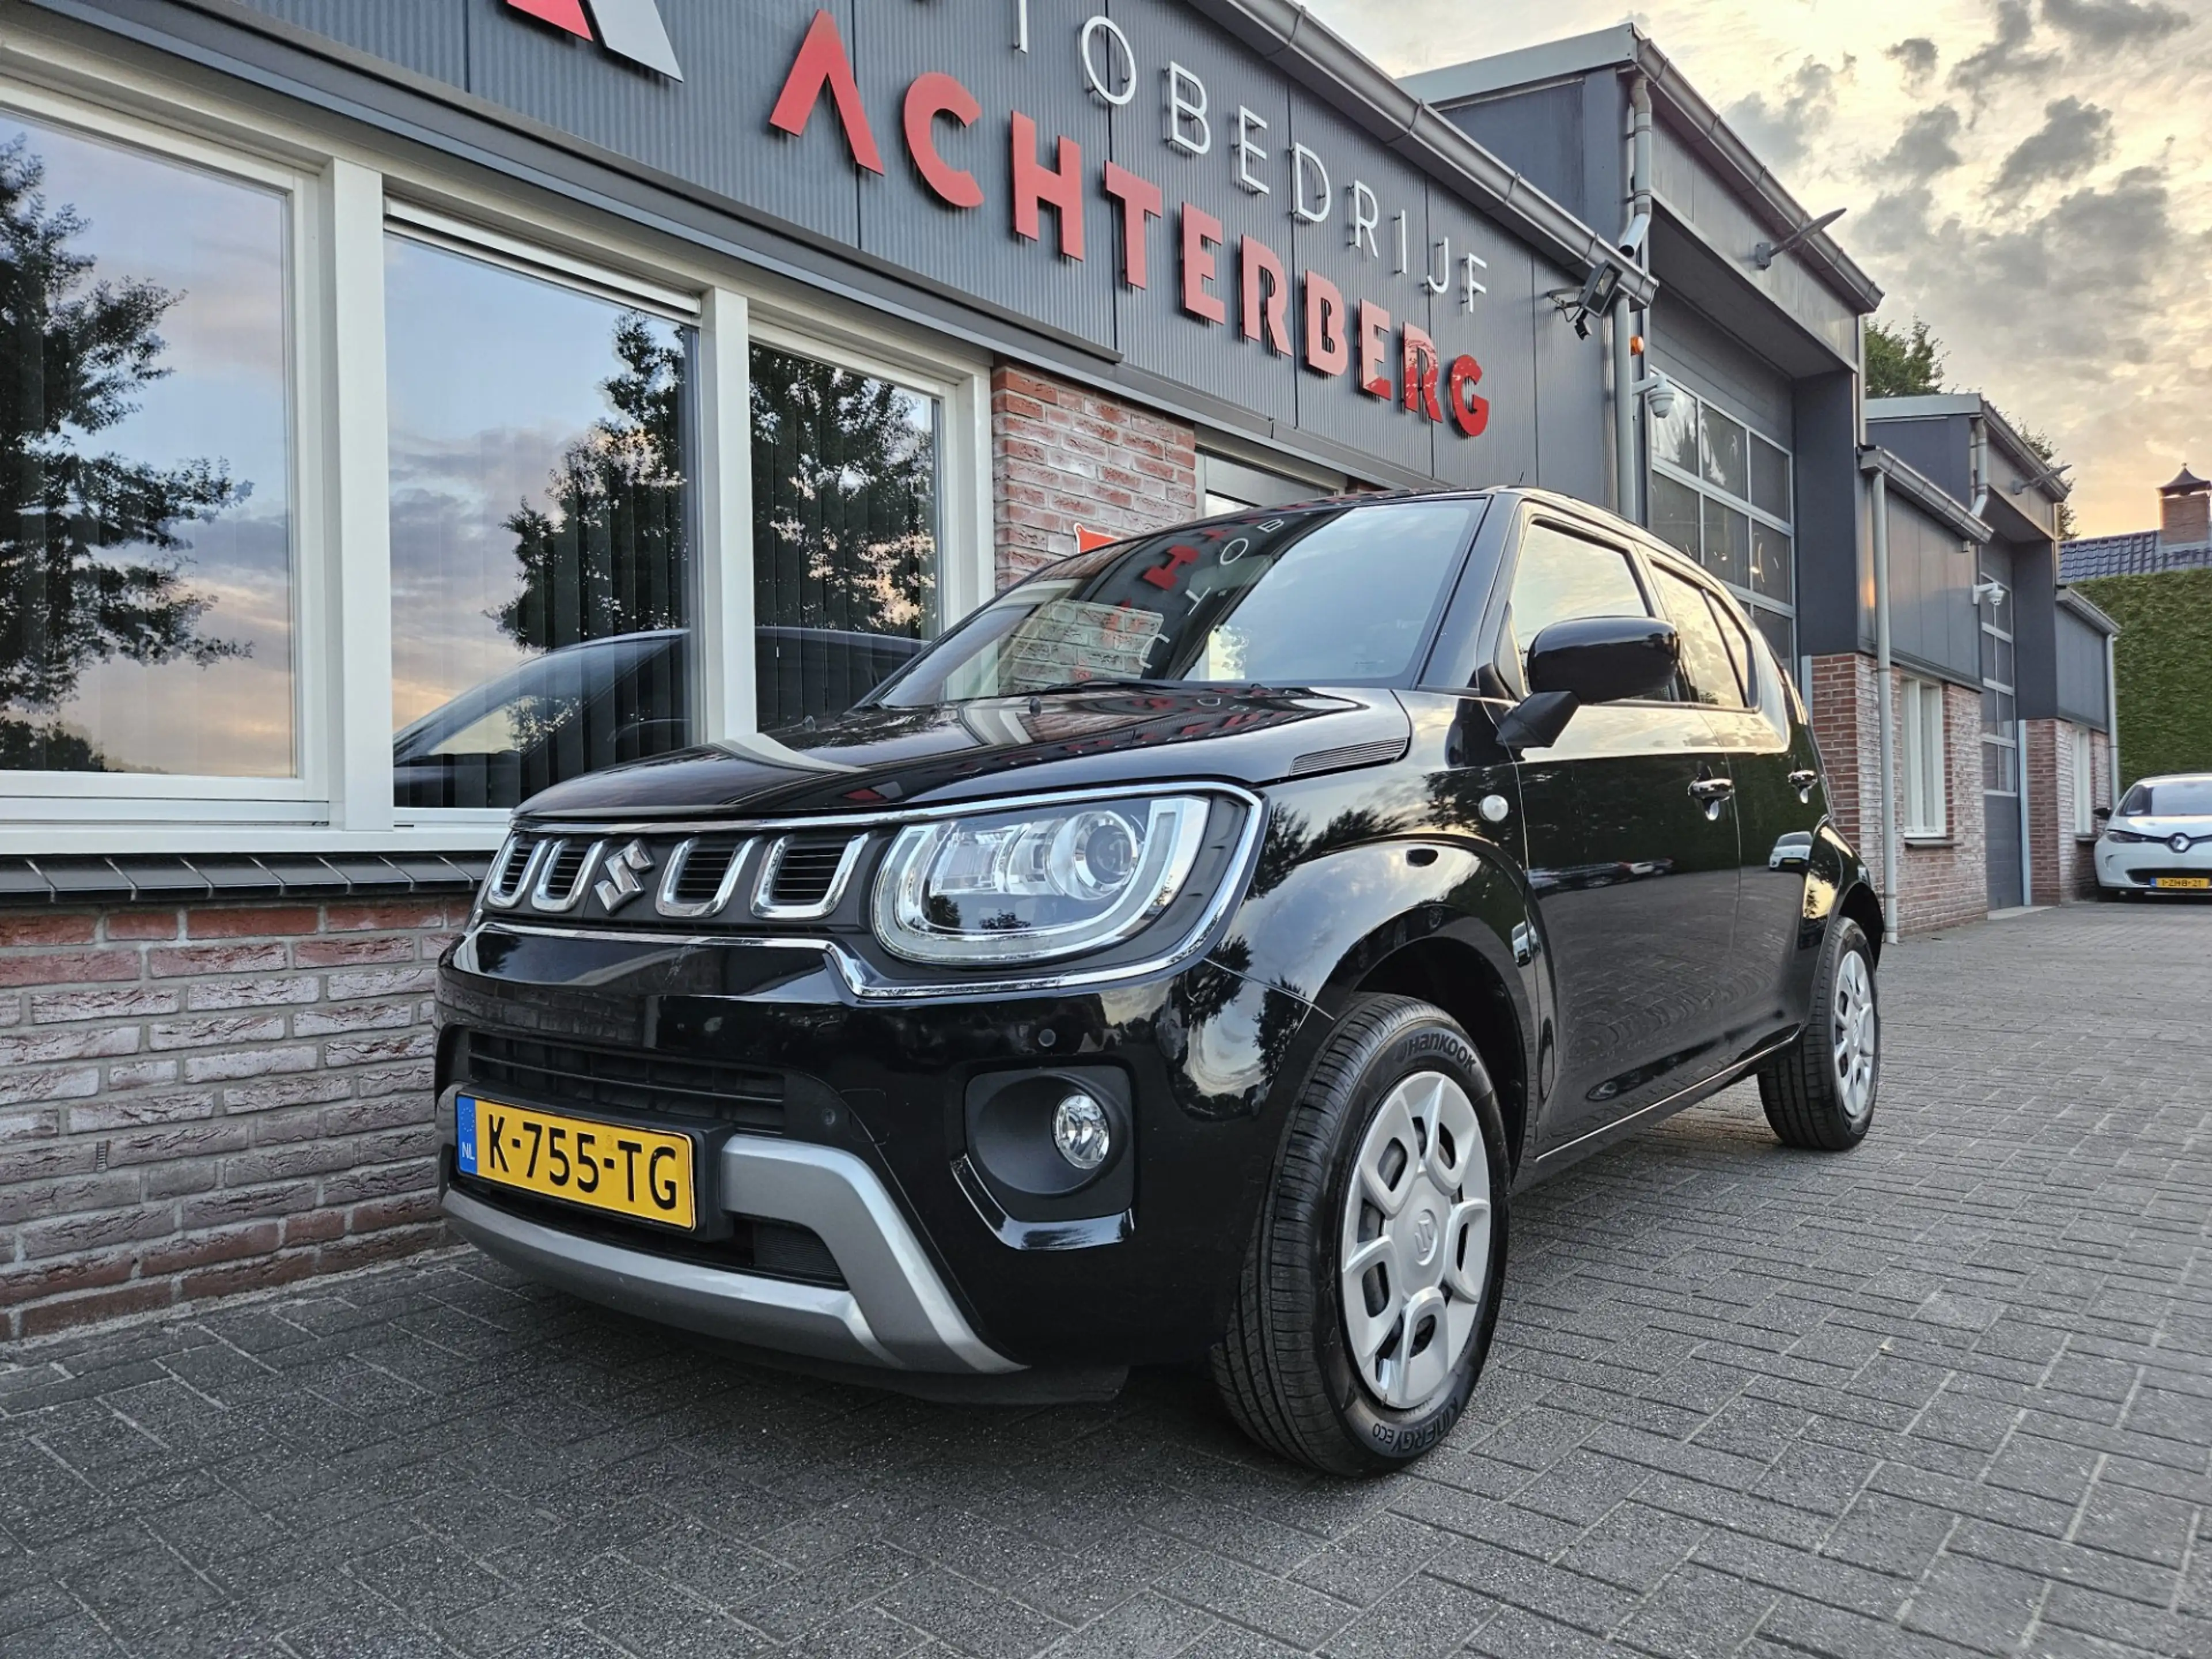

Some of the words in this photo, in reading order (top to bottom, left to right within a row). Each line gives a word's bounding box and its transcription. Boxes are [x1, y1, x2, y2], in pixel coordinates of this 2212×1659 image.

[770, 9, 1490, 437] ACHTERBERG
[461, 1142, 475, 1161] NL
[488, 1113, 677, 1210] K-755-TG
[1372, 1423, 1395, 1444] ECO
